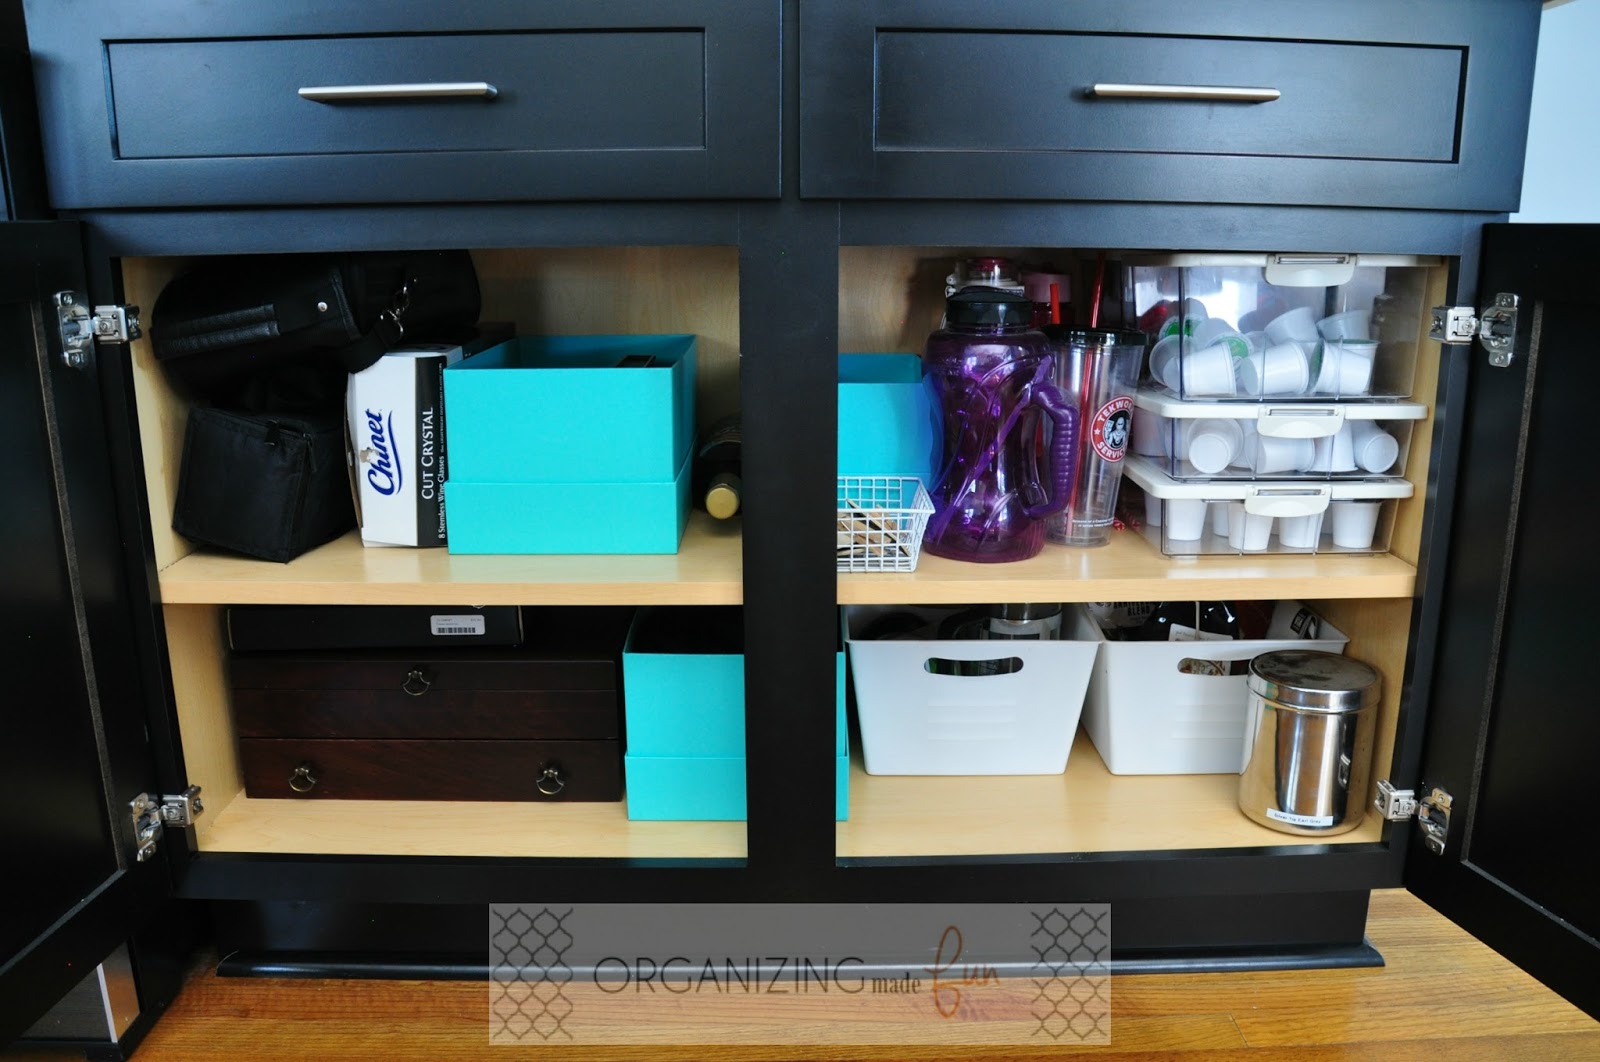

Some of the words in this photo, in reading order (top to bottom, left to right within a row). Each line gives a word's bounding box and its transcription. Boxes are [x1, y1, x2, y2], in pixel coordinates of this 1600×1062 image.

[421, 407, 434, 467] CRYSTAL
[1097, 441, 1127, 459] SERVIC
[365, 408, 395, 496] Chinet
[437, 456, 445, 483] Glasses
[421, 473, 434, 499] CUT
